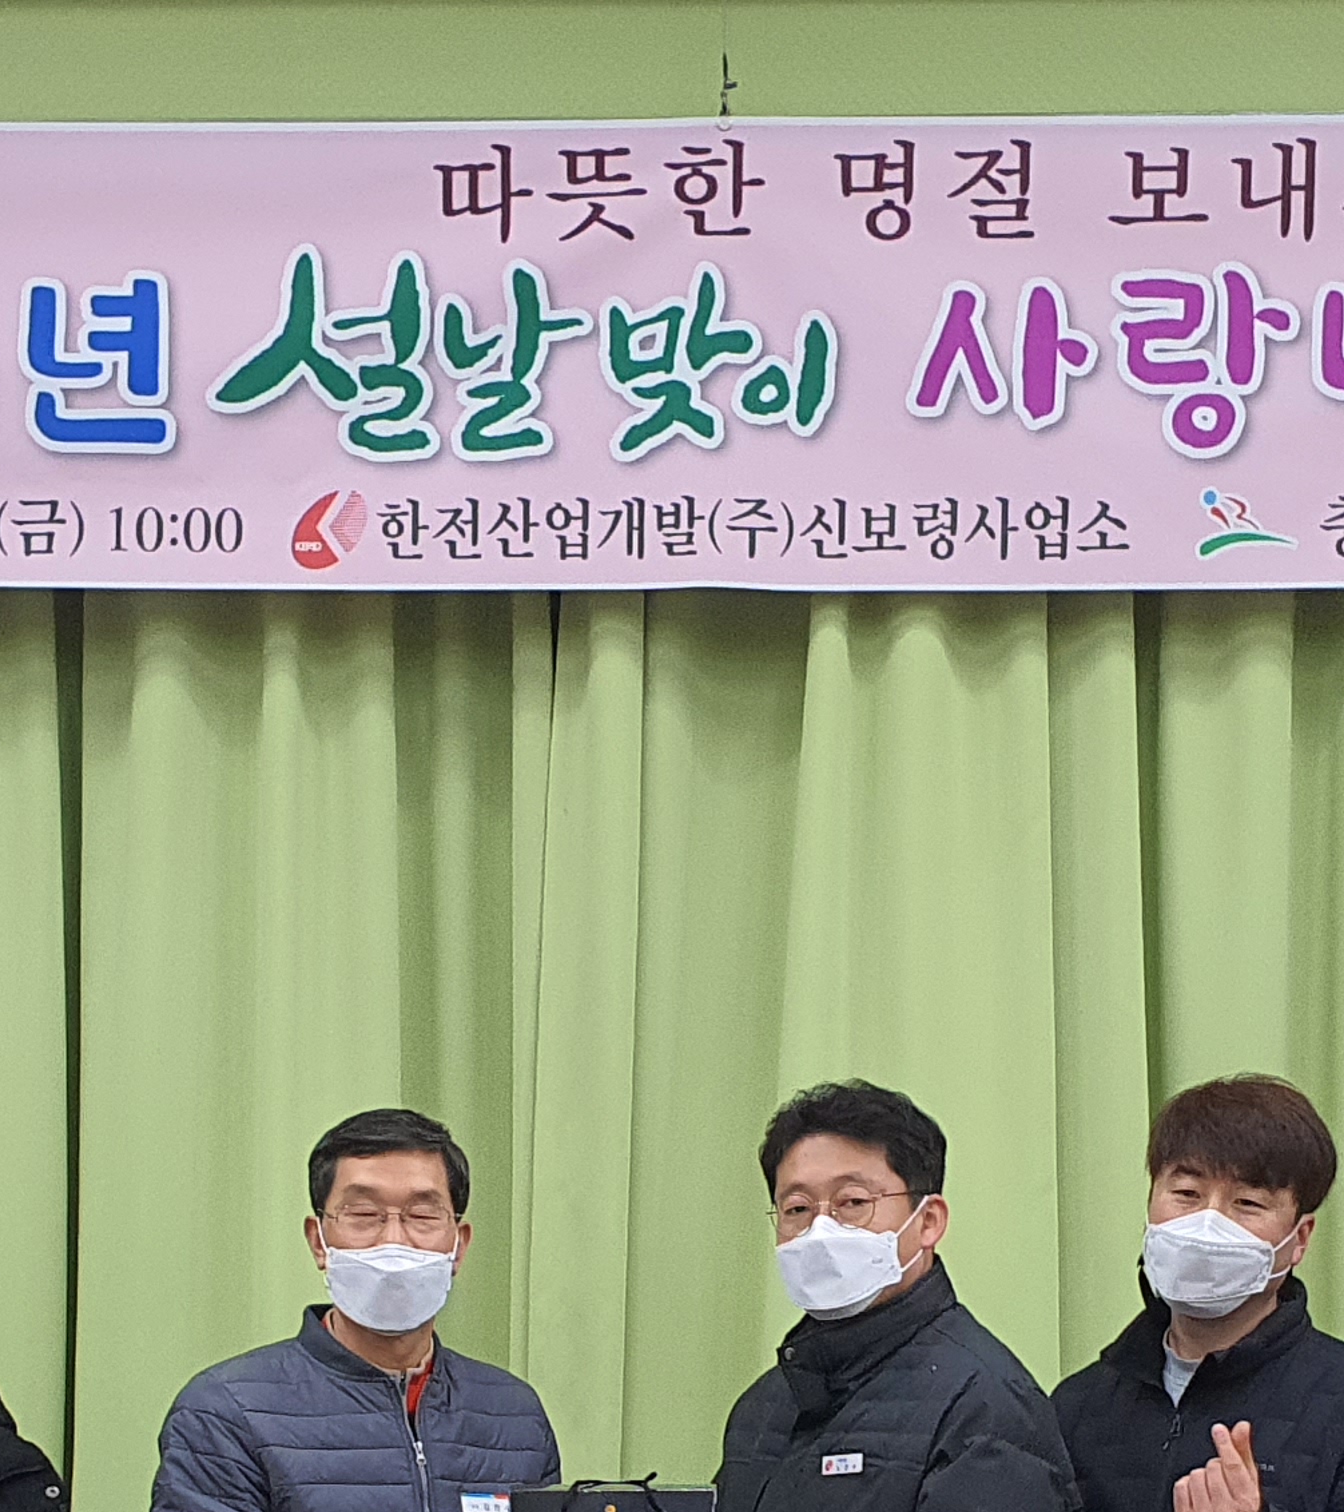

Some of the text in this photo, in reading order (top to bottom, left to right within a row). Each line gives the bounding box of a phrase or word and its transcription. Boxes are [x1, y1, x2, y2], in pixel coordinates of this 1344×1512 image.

[433, 140, 766, 244] 따뜻한
[833, 140, 1037, 242] 명절
[211, 250, 831, 455] 설날맞이
[110, 506, 245, 554] 10:00
